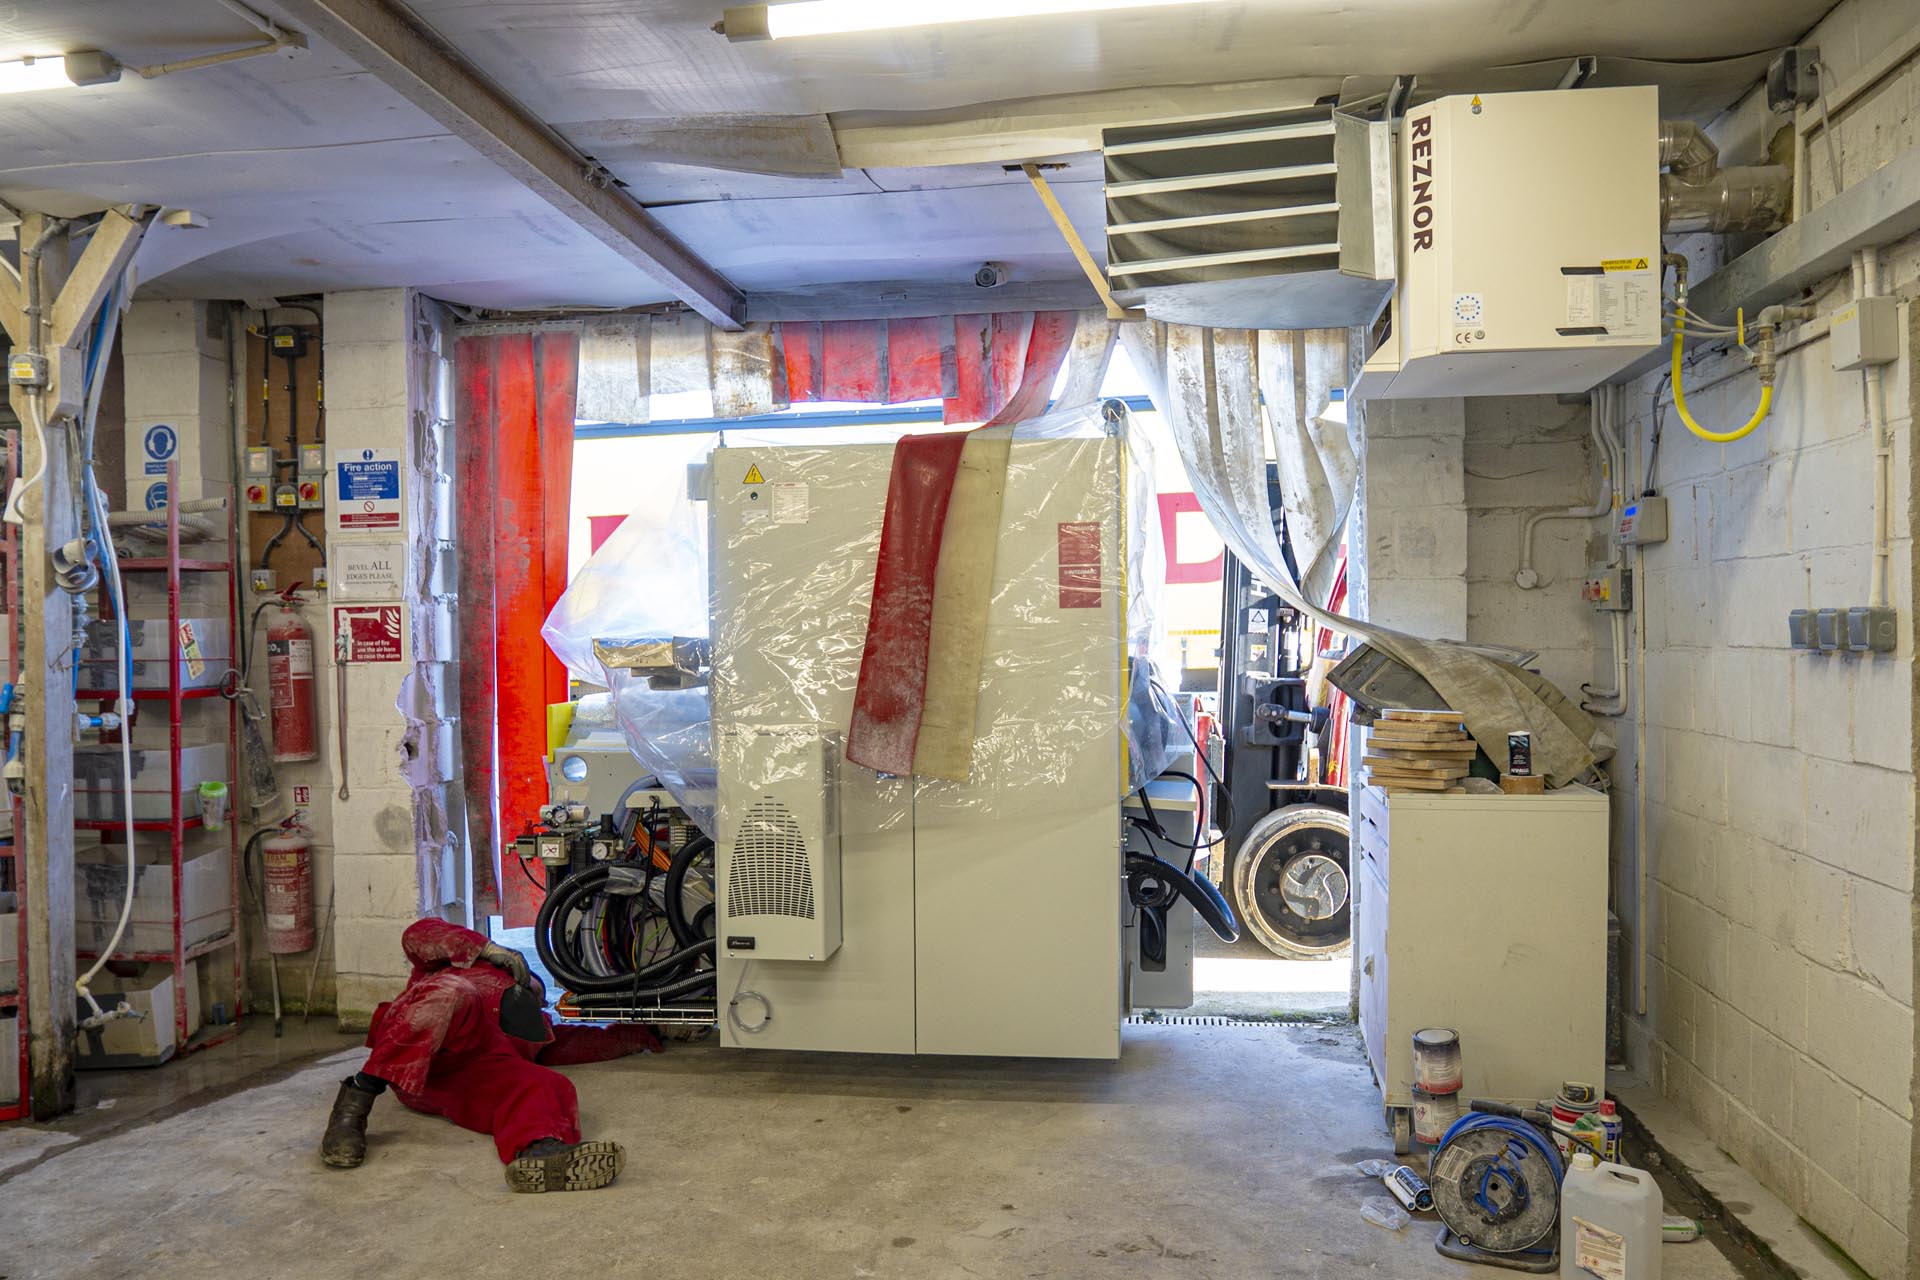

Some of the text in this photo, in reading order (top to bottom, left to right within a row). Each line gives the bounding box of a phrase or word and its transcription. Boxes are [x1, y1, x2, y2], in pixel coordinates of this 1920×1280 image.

[1411, 115, 1433, 254] REZNOR
[344, 463, 392, 472] Fire action
[371, 561, 392, 570] ALL
